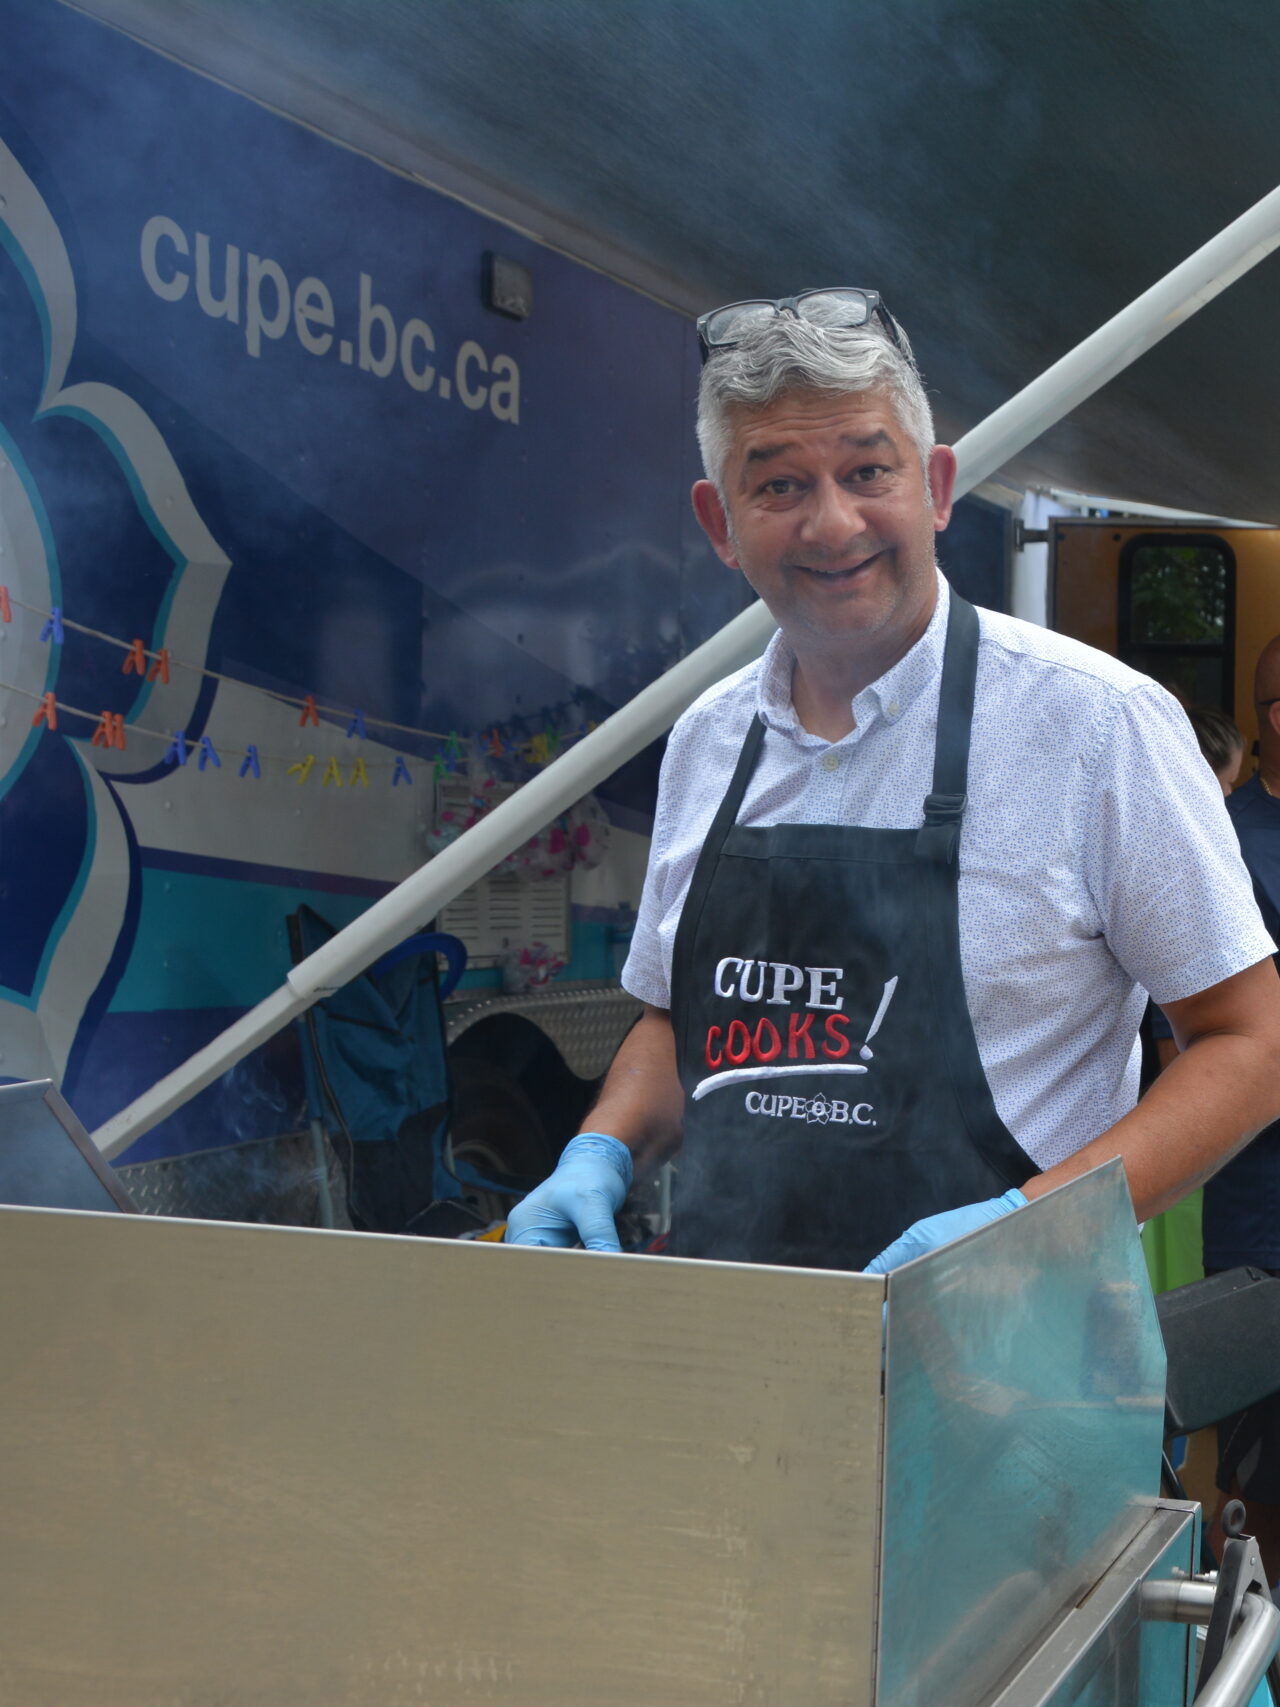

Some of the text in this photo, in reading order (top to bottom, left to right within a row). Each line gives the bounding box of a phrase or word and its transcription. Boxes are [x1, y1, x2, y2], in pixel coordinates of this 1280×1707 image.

[139, 214, 521, 425] cupe.bc.ca
[714, 957, 844, 1010] CUPE
[744, 1091, 877, 1126] CUPE B.C.
